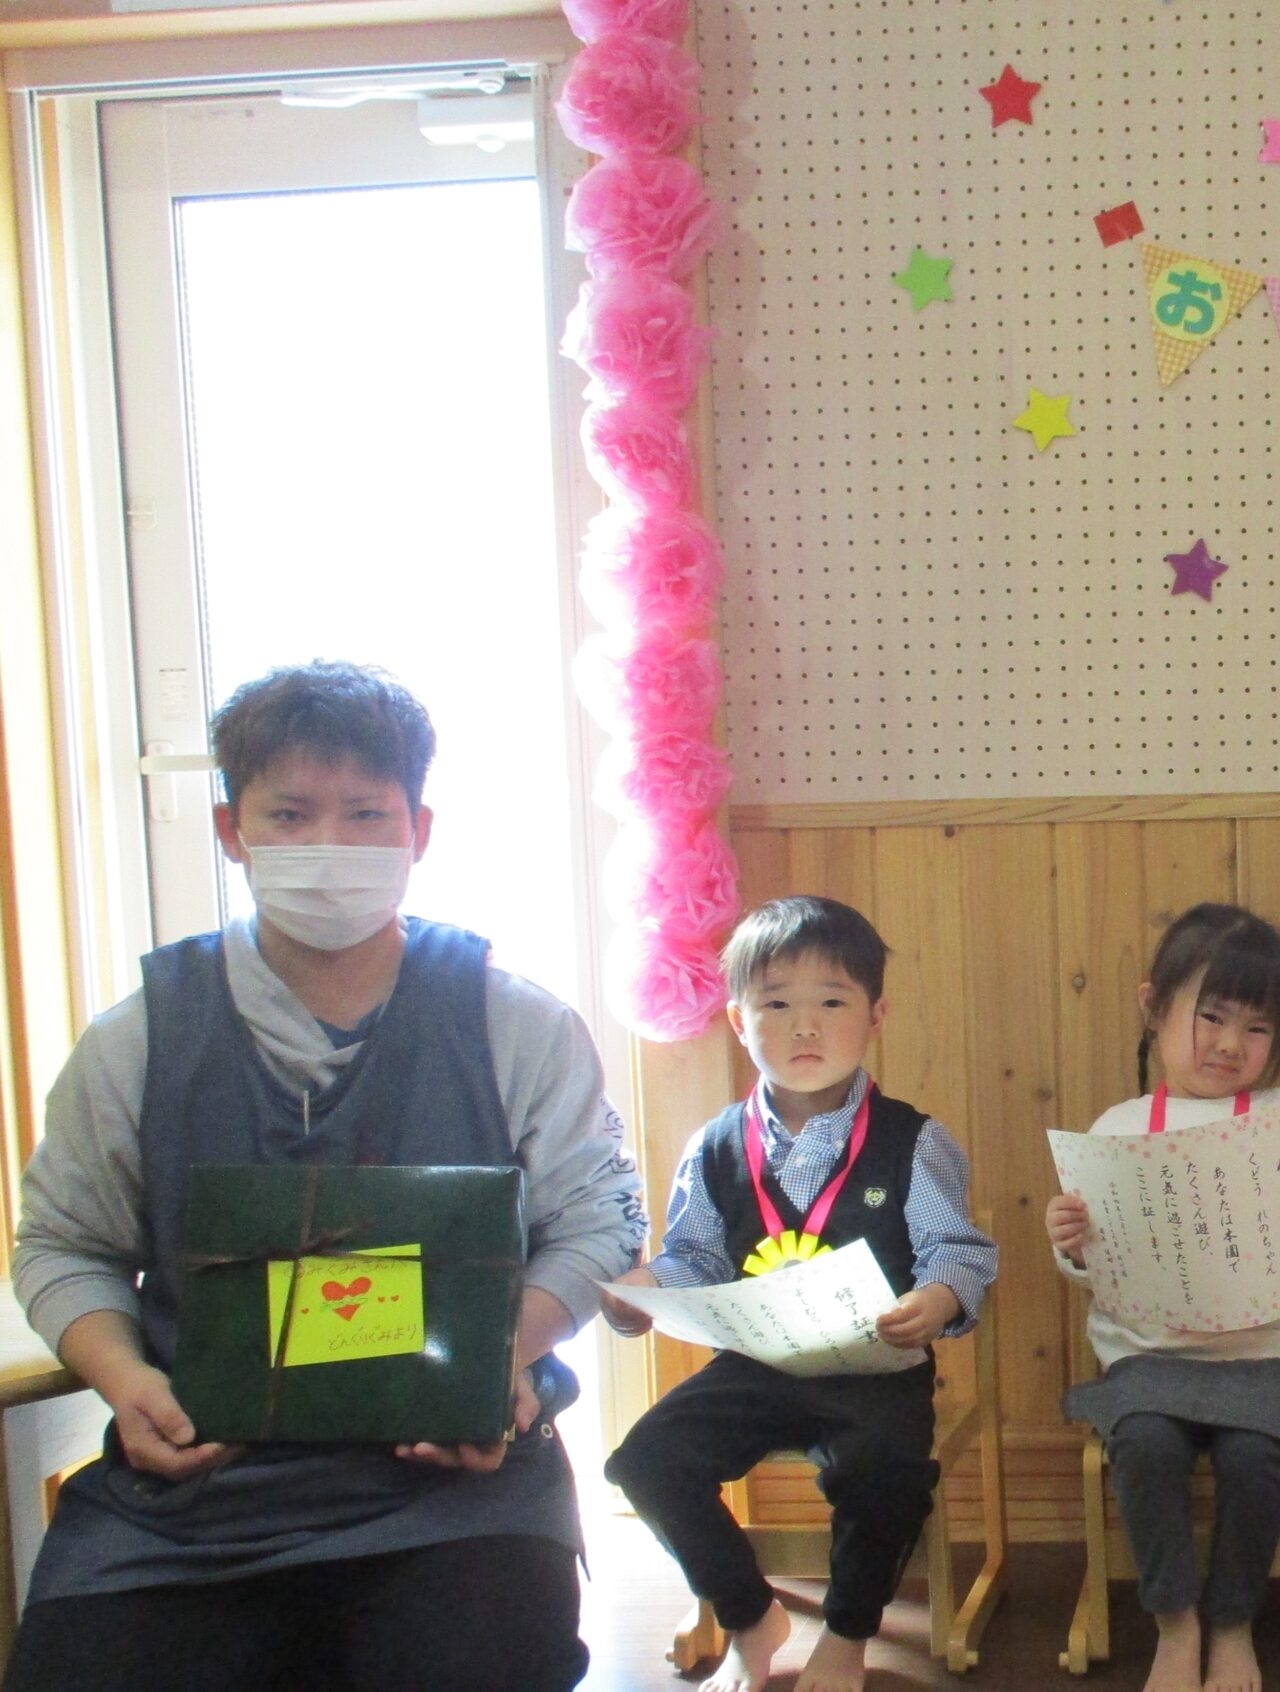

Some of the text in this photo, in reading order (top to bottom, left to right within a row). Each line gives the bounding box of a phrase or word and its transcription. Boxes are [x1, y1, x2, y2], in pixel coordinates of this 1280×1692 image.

[1213, 1166, 1240, 1274] あなたは本園で
